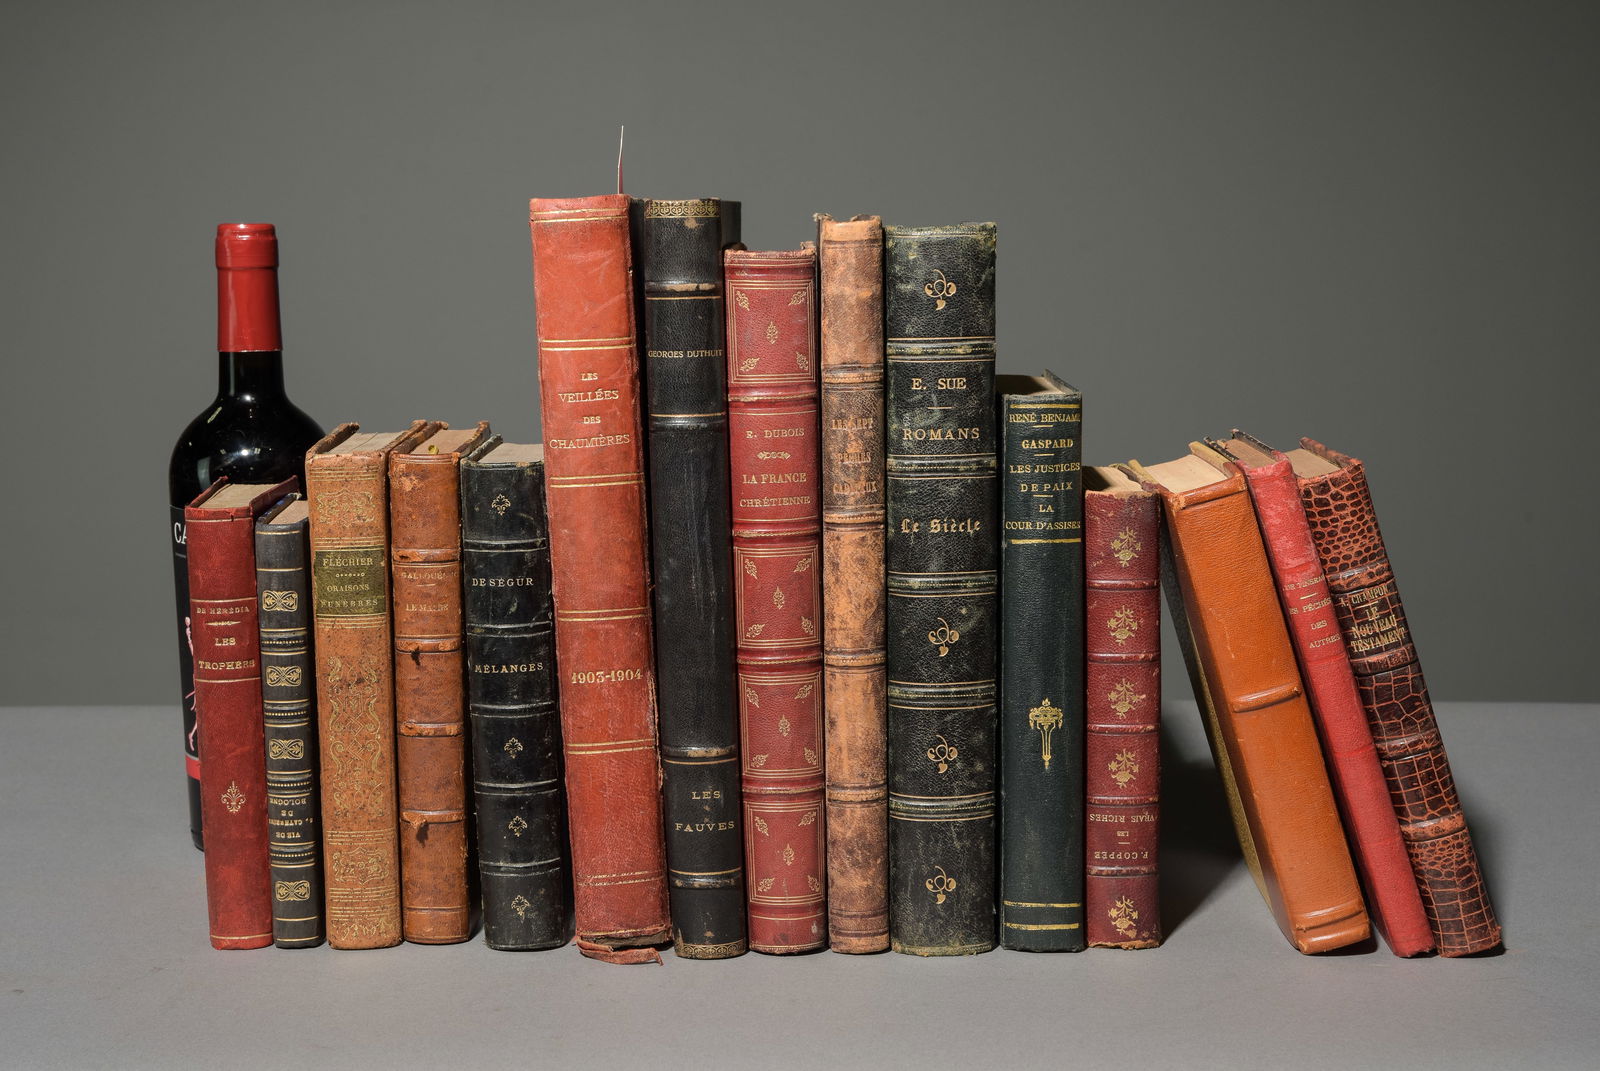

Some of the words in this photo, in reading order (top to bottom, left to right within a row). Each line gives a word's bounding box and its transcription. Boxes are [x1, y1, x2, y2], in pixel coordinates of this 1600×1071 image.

[648, 350, 684, 358] GEORGES
[687, 349, 722, 358] DUTHUIT
[580, 373, 598, 381] LES
[912, 378, 927, 390] E.
[938, 378, 966, 390] SUE
[558, 388, 619, 402] VEILLÉES
[583, 416, 601, 424] DES
[1009, 412, 1037, 422] RENÉ
[764, 428, 804, 438] DUBOIS
[902, 428, 980, 441] ROMANS
[550, 434, 630, 448] CHAUMIÈRES
[1022, 438, 1074, 449] GASPARD
[1010, 464, 1031, 474] LES
[1034, 462, 1080, 473] JUSTICES
[742, 474, 758, 484] LA
[761, 472, 806, 484] FRANCE
[1020, 483, 1038, 492] DE
[1044, 482, 1073, 492] PAIX
[740, 496, 811, 508] CHRÉTIENNE
[1039, 504, 1054, 512] LA
[1006, 521, 1032, 530] COUR
[322, 557, 373, 566] FLÉCHIER
[472, 578, 486, 586] DE
[327, 584, 370, 592] ORAISONS
[1366, 606, 1380, 620] LE
[1310, 620, 1328, 630] DES
[215, 637, 236, 646] LES
[1310, 633, 1341, 648] AUTRES
[1351, 626, 1405, 652] TESTAMENT
[474, 662, 544, 674] MÉLANGES
[570, 668, 644, 684] 1903-1904
[692, 790, 720, 800] LES
[1090, 813, 1126, 823] RICHES
[1130, 814, 1155, 823] VRAIS
[675, 821, 735, 832] FAUVES
